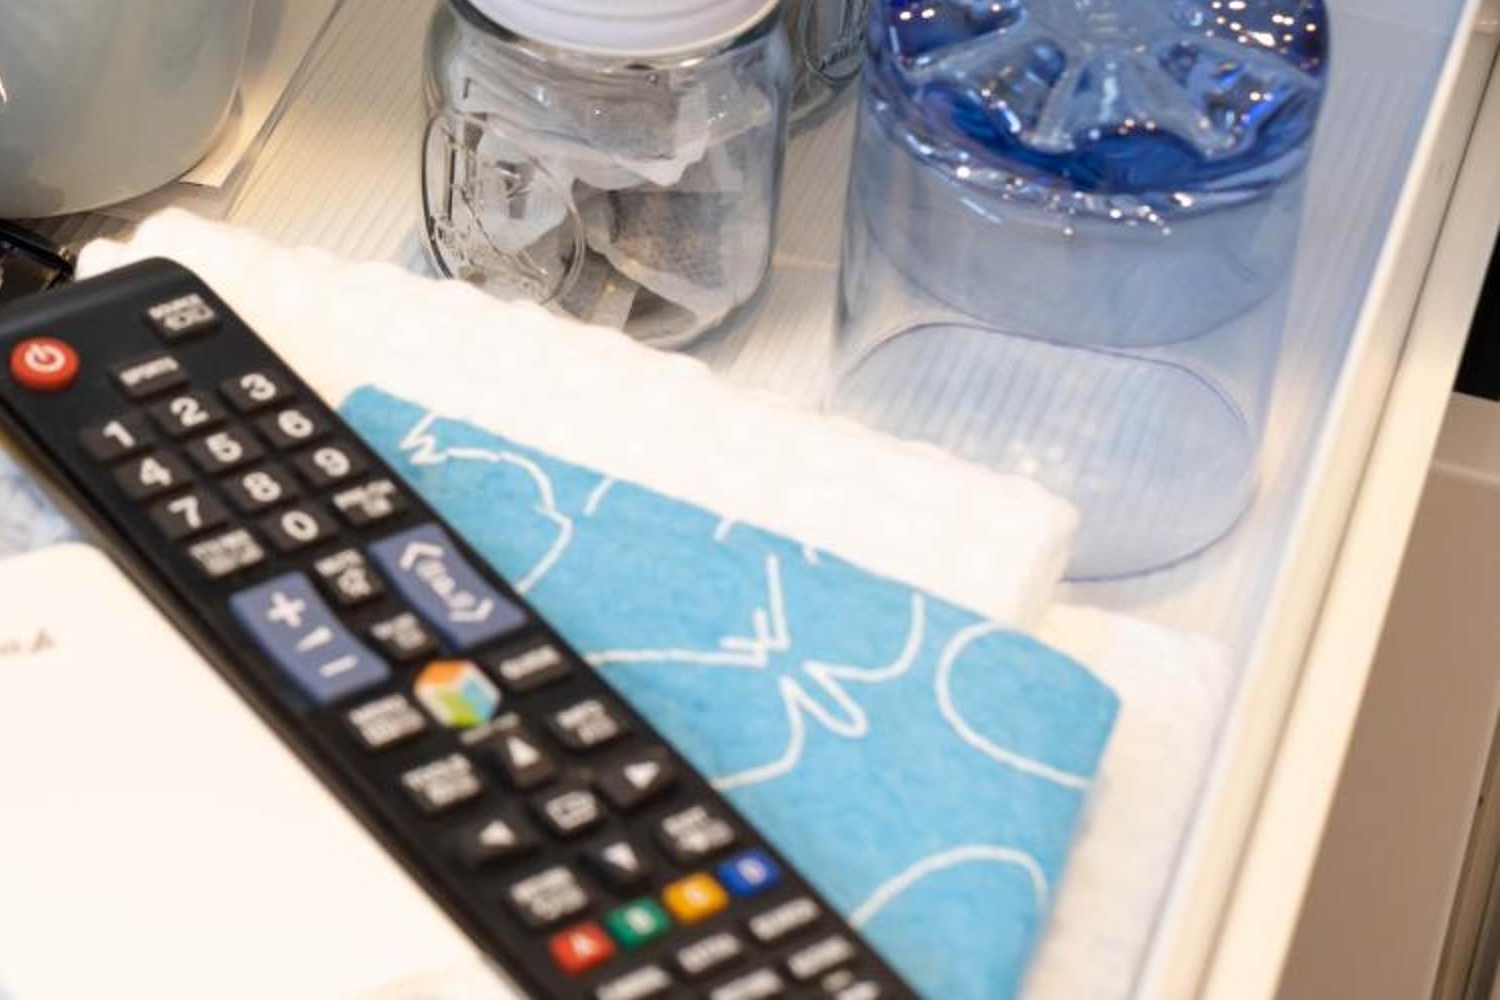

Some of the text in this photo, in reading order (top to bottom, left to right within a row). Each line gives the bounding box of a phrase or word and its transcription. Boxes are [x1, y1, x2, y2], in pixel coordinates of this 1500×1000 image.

[103, 373, 276, 448] 1 2 3
[140, 409, 313, 486] 4 5 6
[167, 447, 349, 528] 7 8 9
